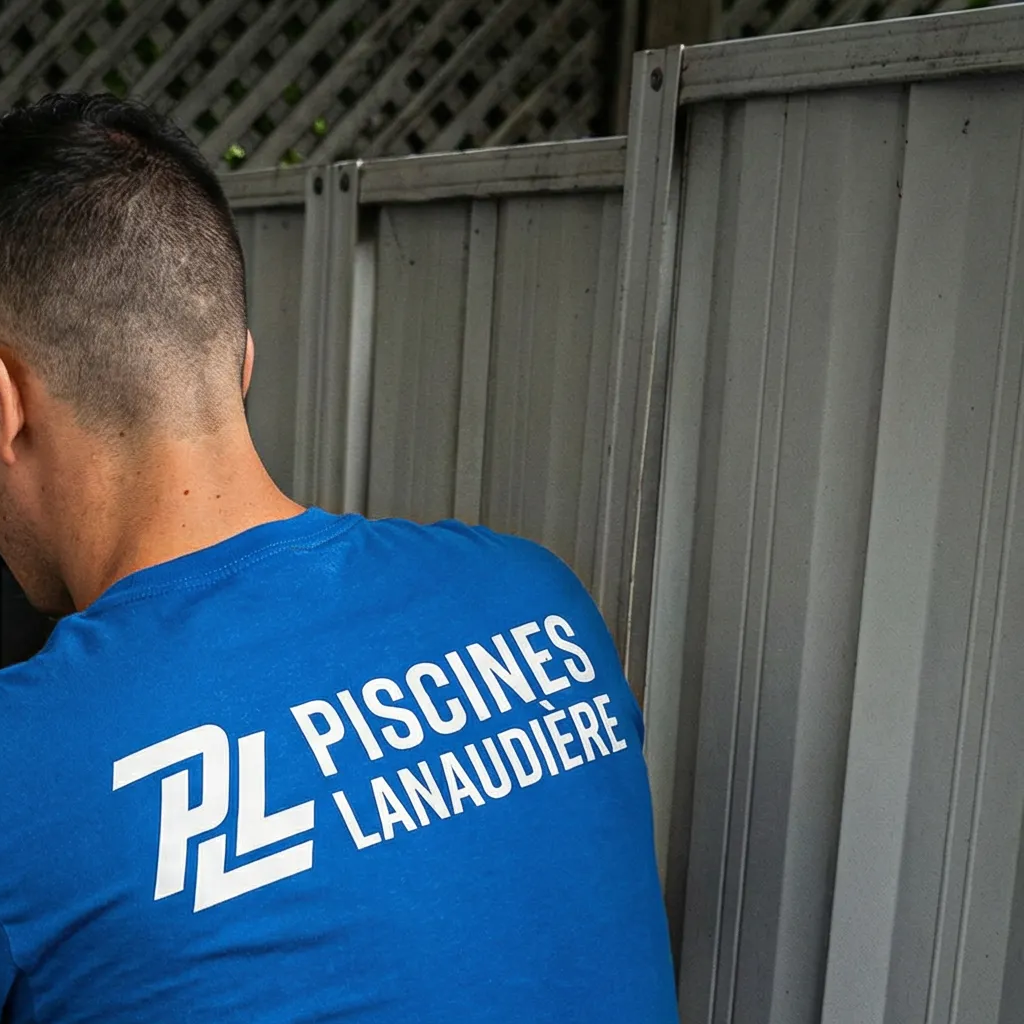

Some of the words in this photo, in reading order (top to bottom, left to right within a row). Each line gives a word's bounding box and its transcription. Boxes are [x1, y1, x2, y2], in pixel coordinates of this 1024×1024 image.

[289, 614, 596, 777] PISCINES
[332, 694, 628, 850] LANAUDIÈRE
[112, 724, 314, 913] PL
